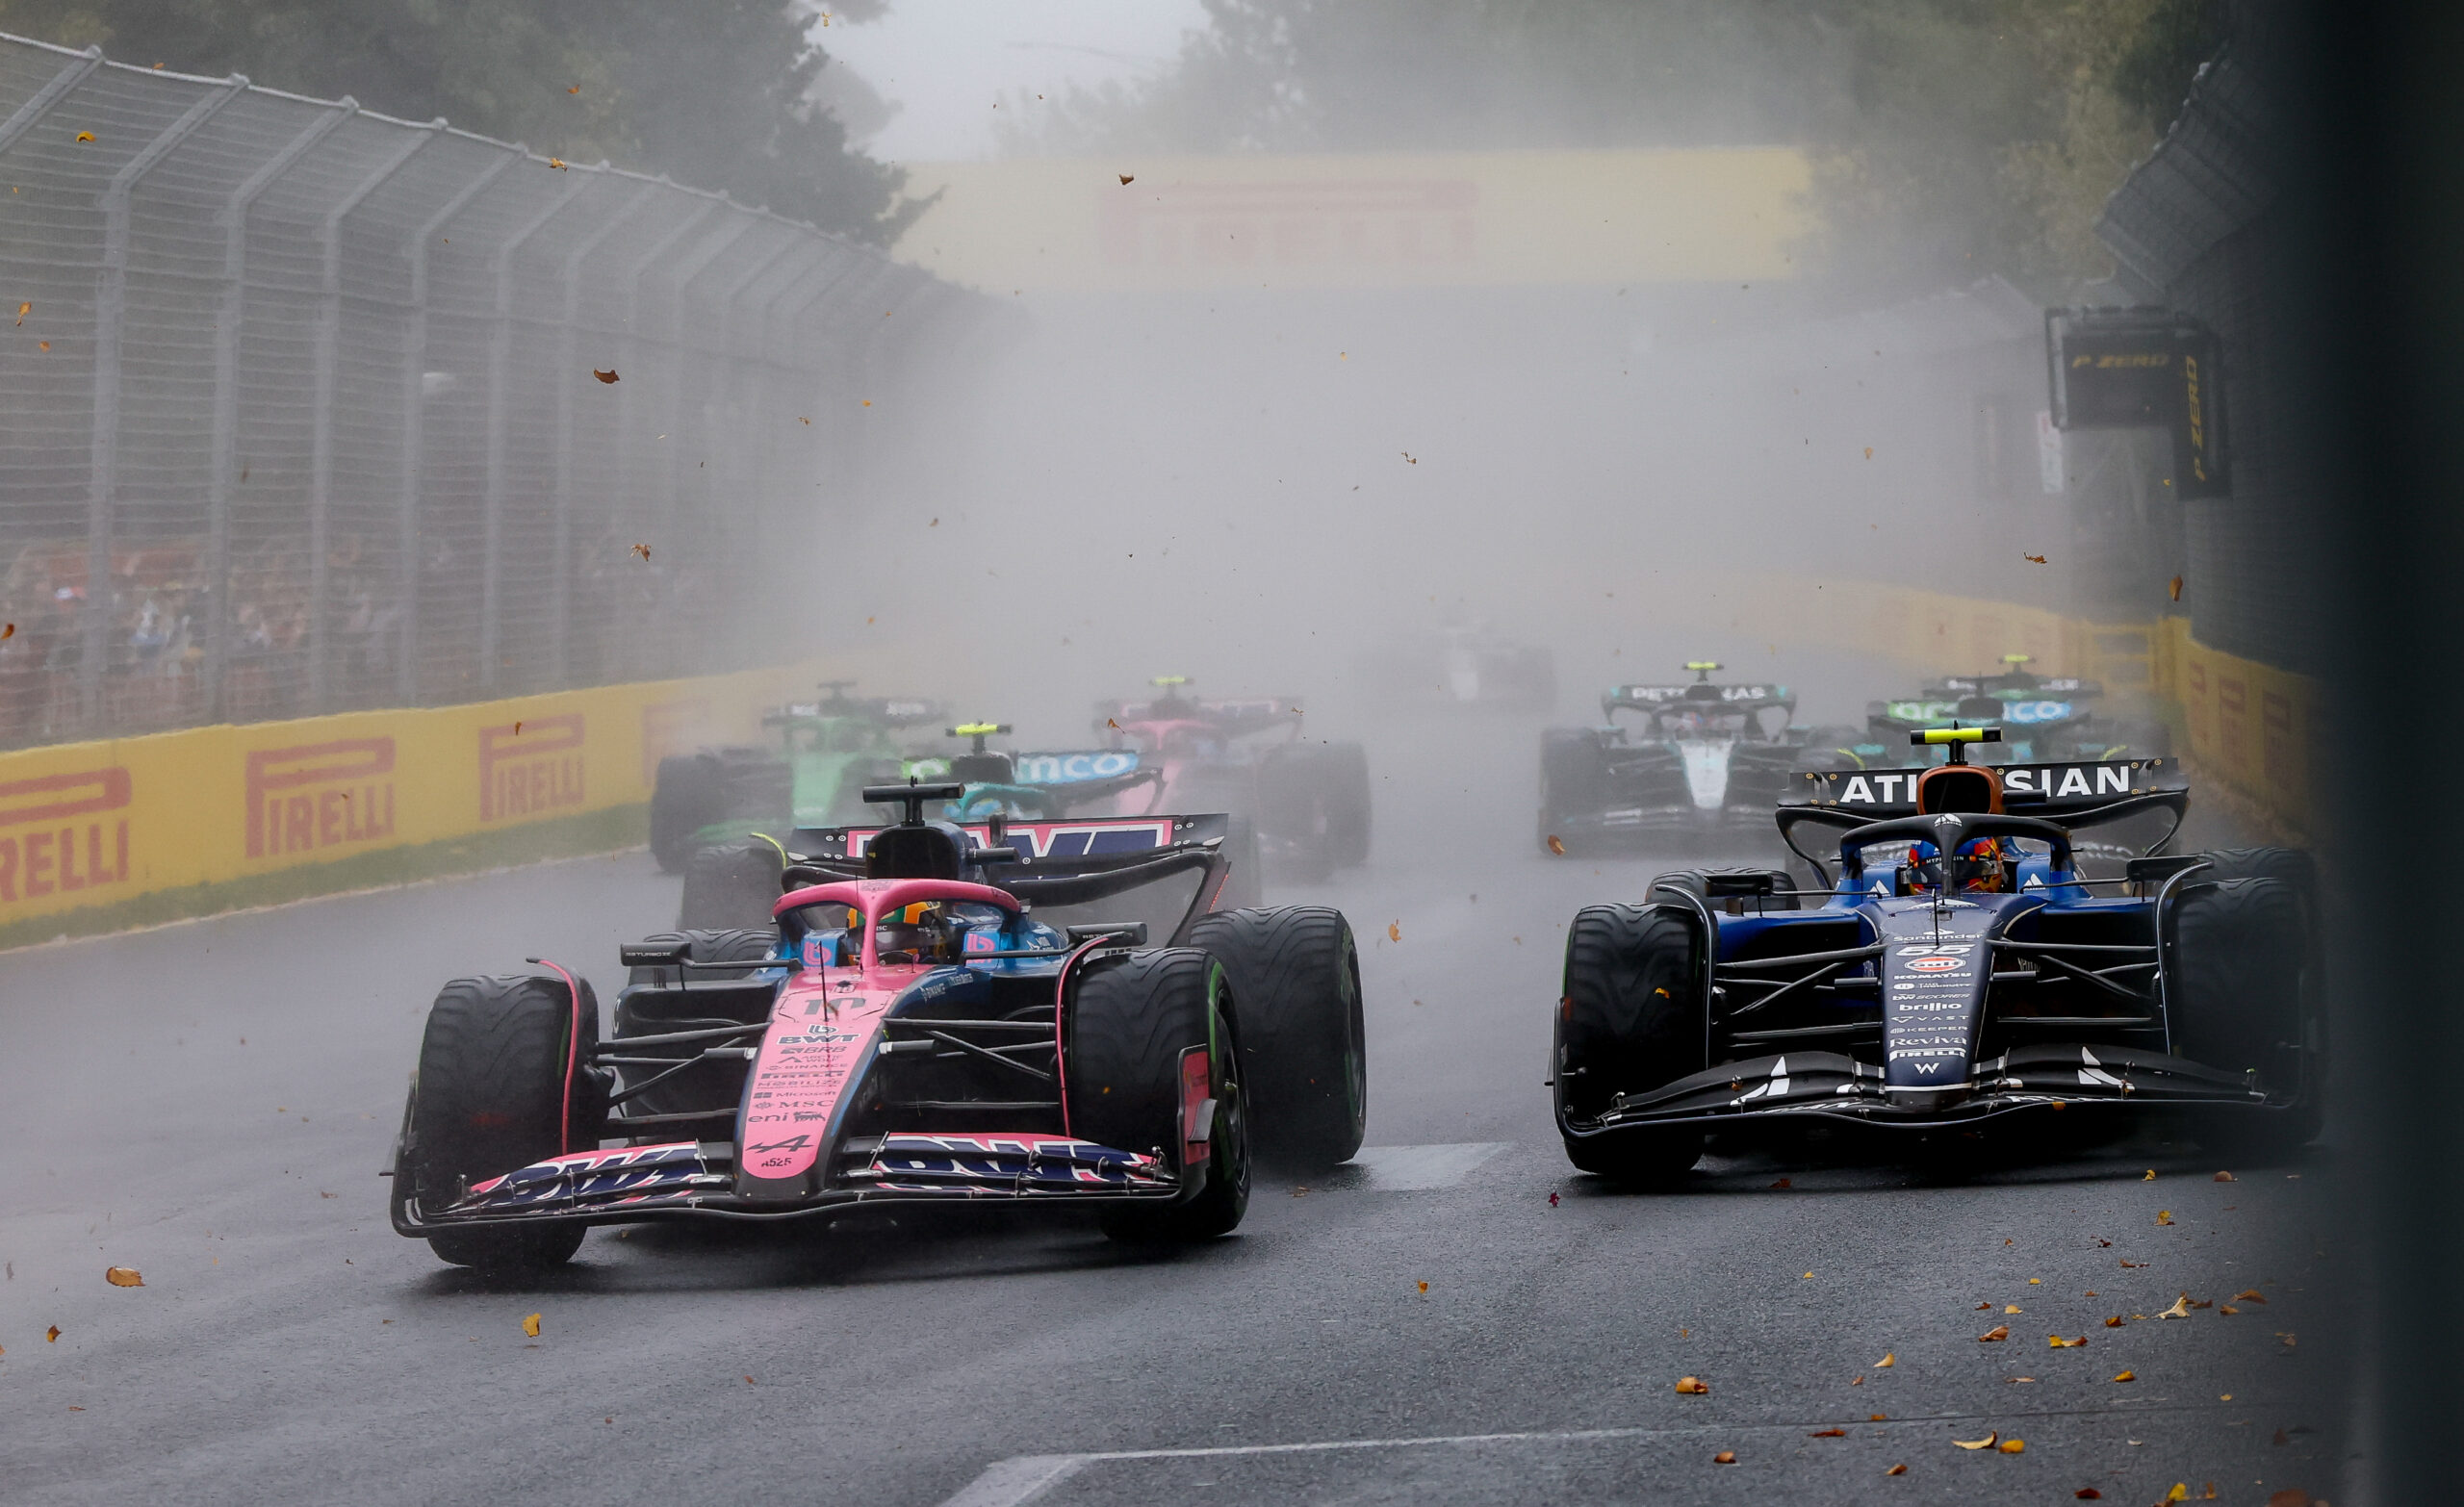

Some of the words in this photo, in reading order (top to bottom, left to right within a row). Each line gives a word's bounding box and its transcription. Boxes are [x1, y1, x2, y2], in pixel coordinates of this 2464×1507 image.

[481, 714, 583, 822] PIRELLI
[246, 736, 396, 857] PIRELLI
[1893, 932, 1984, 942] Santander
[1896, 944, 1976, 957] 55
[804, 997, 866, 1016] 10
[1899, 1002, 1963, 1011] brillio
[779, 1034, 860, 1045] BWT
[1889, 1035, 1967, 1048] Reviva
[1888, 1047, 1966, 1061] PIRELLI
[760, 1070, 845, 1080] PIRELLI
[747, 1111, 788, 1123] eni
